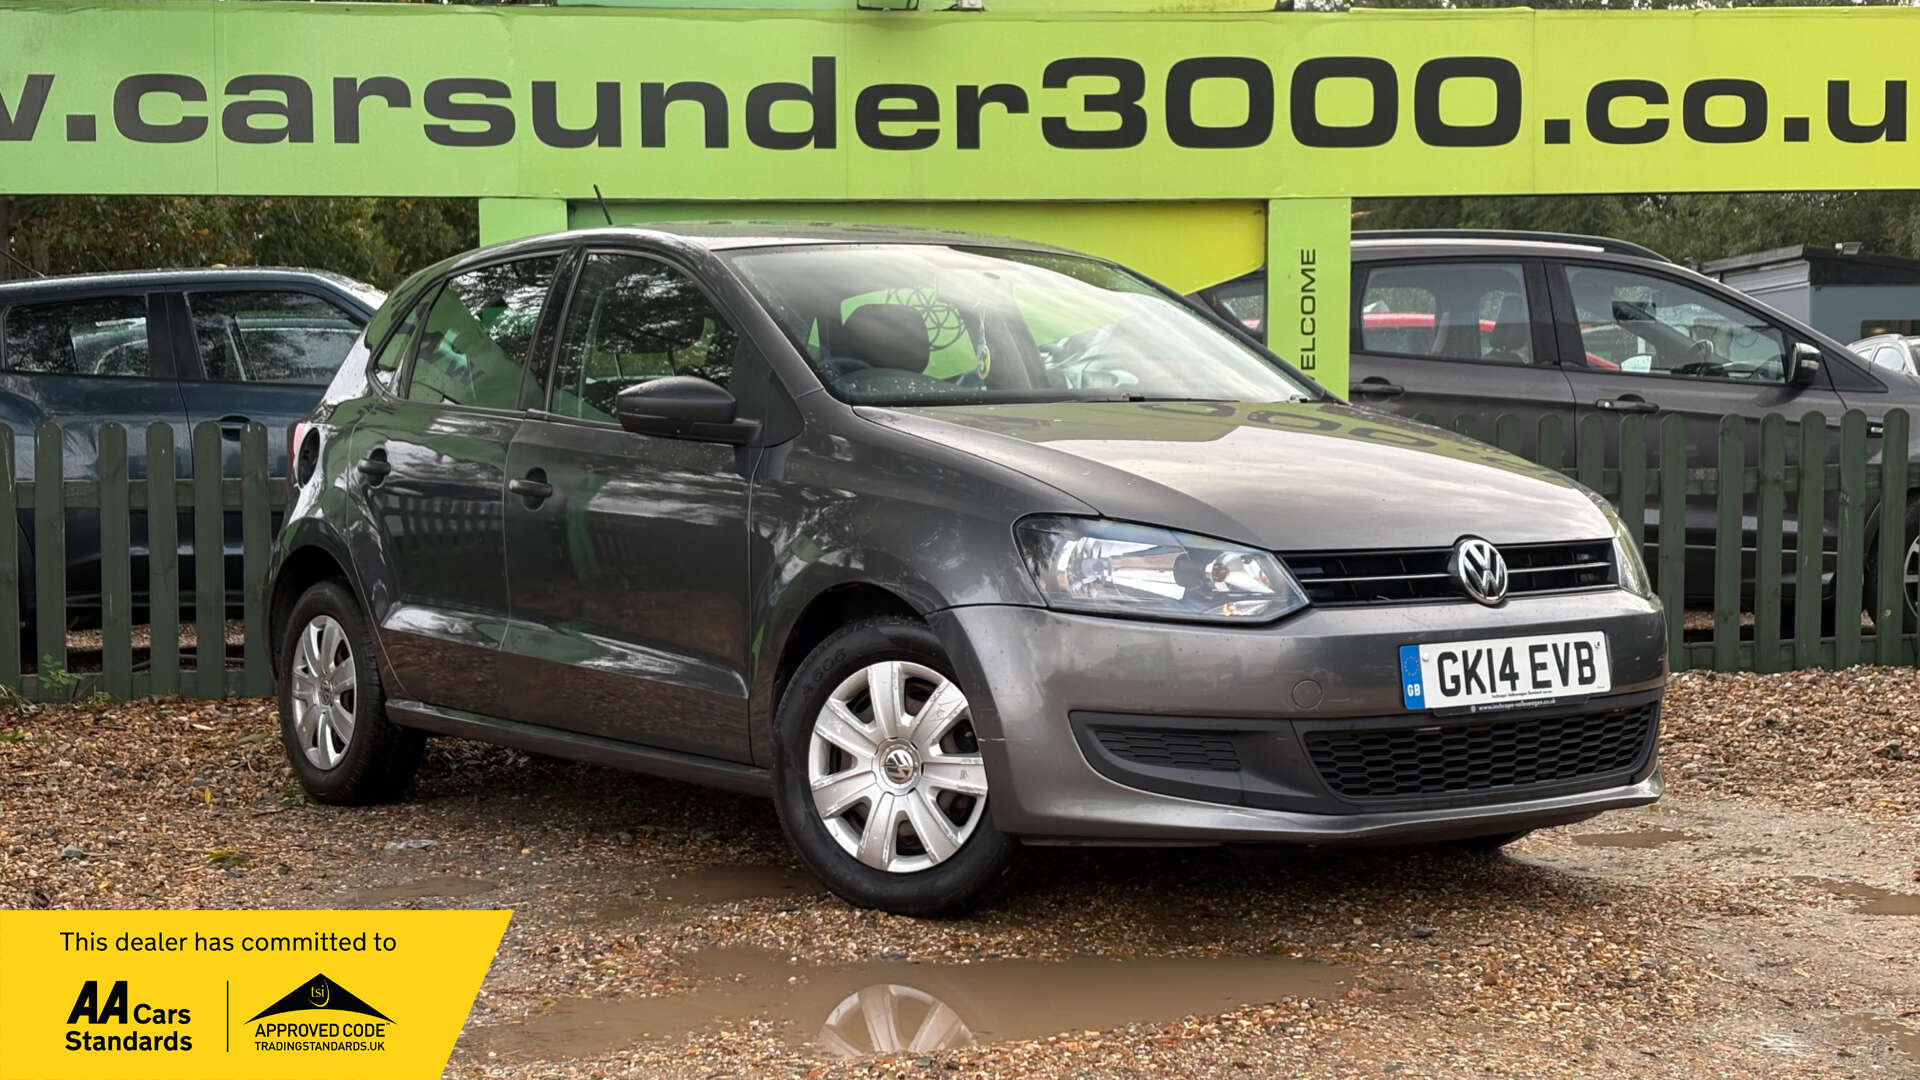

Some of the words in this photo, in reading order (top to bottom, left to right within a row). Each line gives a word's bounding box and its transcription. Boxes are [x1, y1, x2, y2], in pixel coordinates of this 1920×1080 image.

[1301, 249, 1316, 379] ELCOME
[1407, 683, 1421, 697] GB
[1437, 646, 1520, 697] GK14
[1529, 641, 1596, 689] EVB
